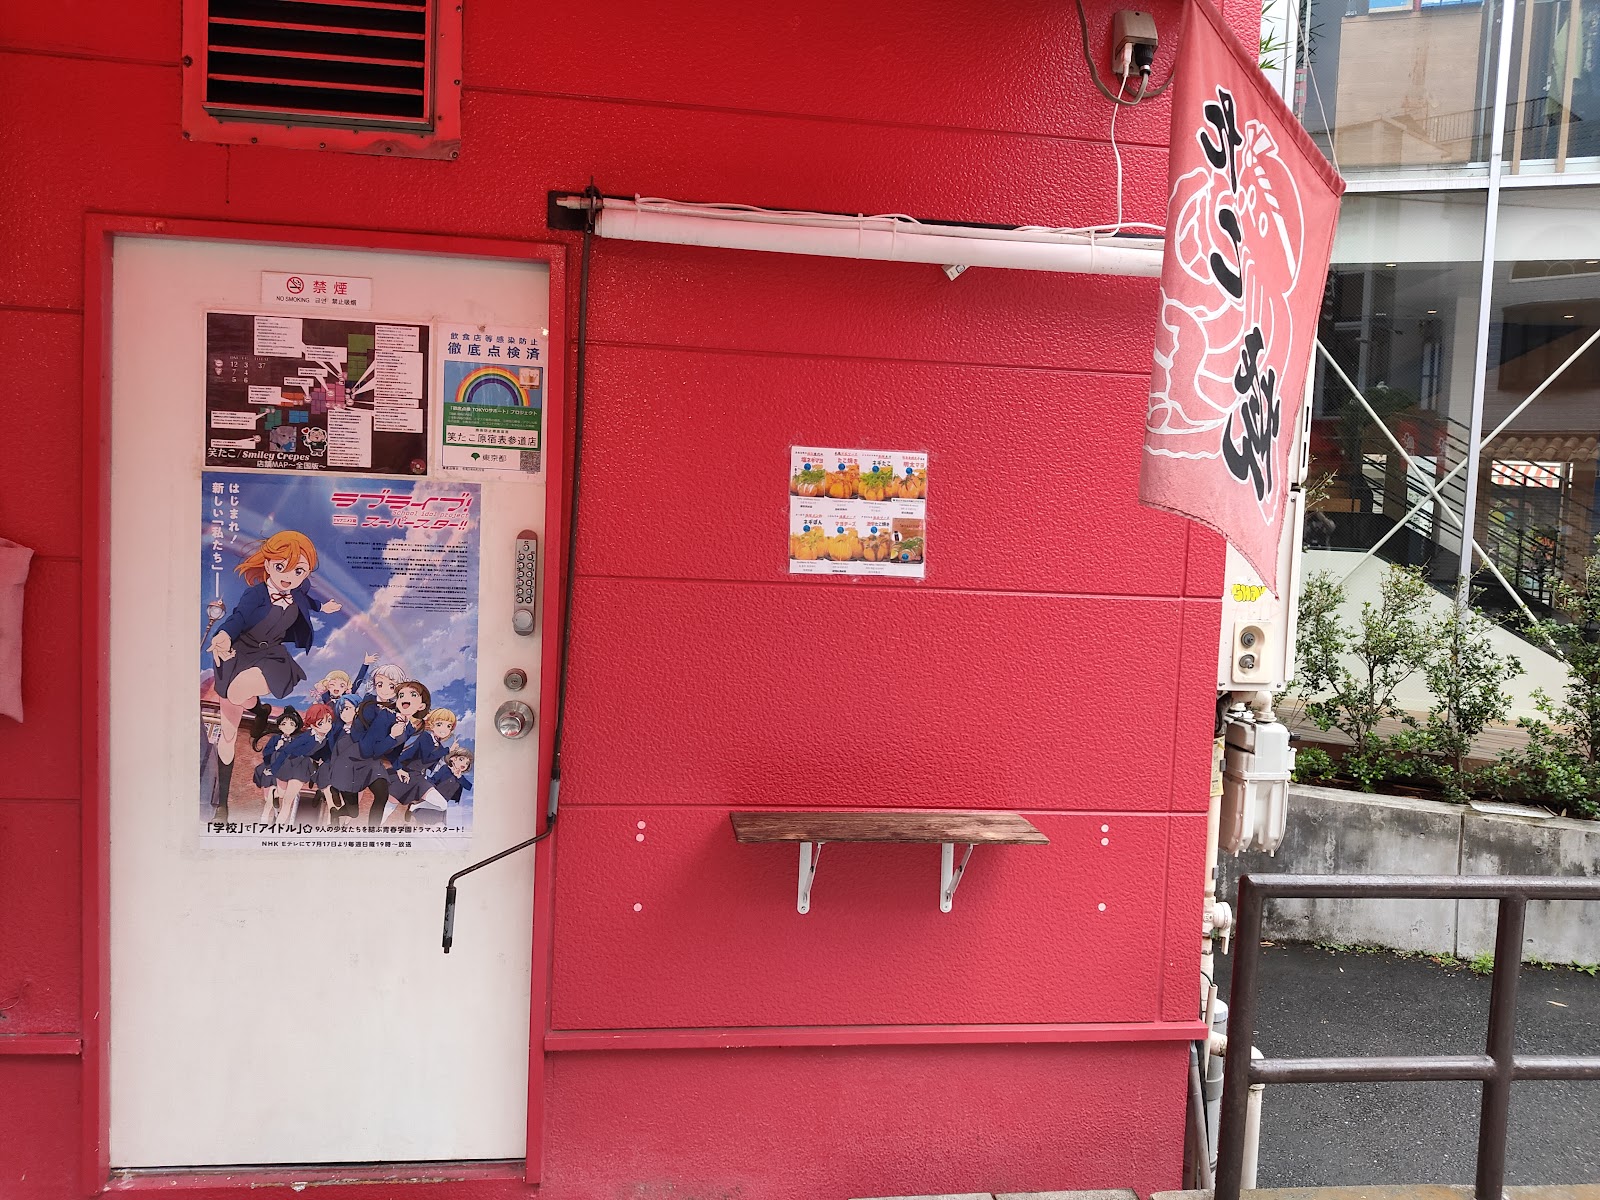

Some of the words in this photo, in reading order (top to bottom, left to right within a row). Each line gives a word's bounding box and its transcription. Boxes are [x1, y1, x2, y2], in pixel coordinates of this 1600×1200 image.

[313, 280, 348, 295] 禁煙
[450, 332, 538, 346] 飲食店等感染防止
[447, 342, 540, 361] 徹底点検済
[447, 432, 537, 446] 笑たこ原宿表参道店
[207, 448, 236, 458] 笑たこ
[242, 451, 276, 461] Smiley
[276, 453, 310, 462] Crepes
[482, 454, 507, 462] 東京都
[331, 489, 473, 512] ラブライブ!
